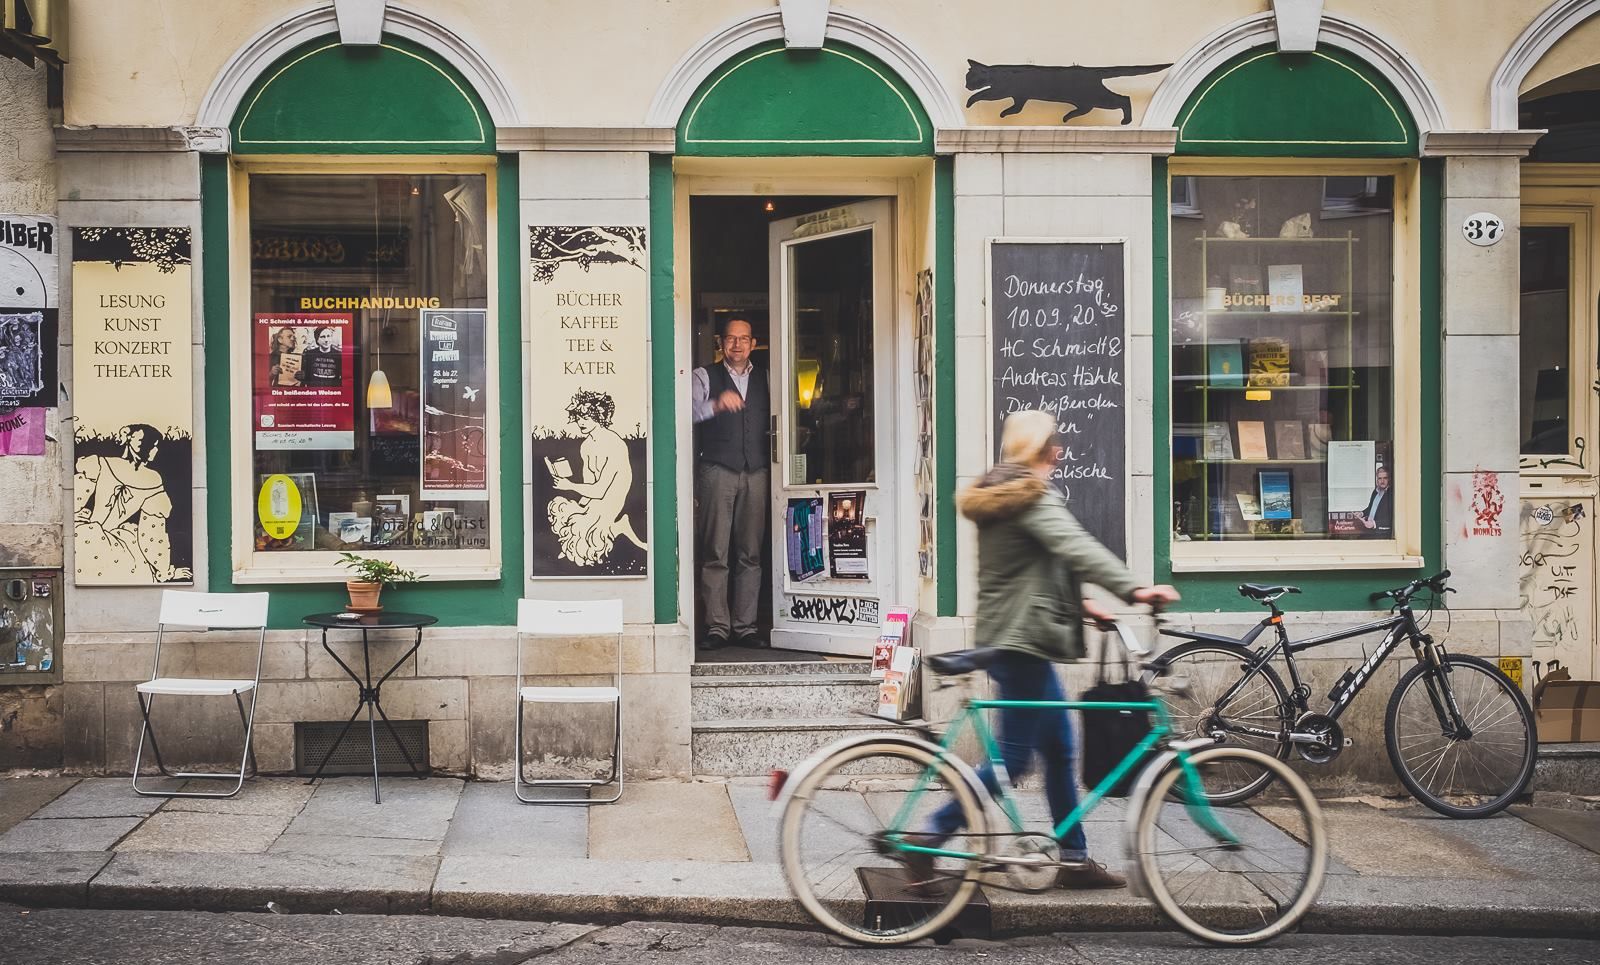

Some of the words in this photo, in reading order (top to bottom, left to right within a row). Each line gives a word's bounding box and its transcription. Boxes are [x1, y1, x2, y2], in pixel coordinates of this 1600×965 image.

[1468, 219, 1500, 239] 37
[0, 220, 53, 254] IBER
[1003, 273, 1110, 306] Donnerstag,
[99, 294, 165, 308] LESUNG
[300, 297, 441, 309] BUCHHANDLUNG
[556, 290, 623, 306] BÜCHER
[1223, 292, 1297, 306] BÜCHERS
[1302, 294, 1342, 306] BEST
[104, 318, 162, 331] KUNST
[560, 316, 619, 329] KAFFEE
[94, 341, 172, 354] KONZERT
[565, 339, 596, 352] TEE
[599, 339, 614, 352] &
[1000, 337, 1025, 357] HC
[1032, 336, 1107, 357] Schmidt
[93, 364, 173, 378] THEATER
[563, 361, 616, 375] KATER
[1001, 366, 1068, 388] Andreas
[1072, 365, 1122, 387] Hähle
[1047, 462, 1113, 480] alische
[430, 517, 439, 532] &
[443, 516, 486, 532] Quist
[1472, 527, 1502, 537] MONKEYS
[1340, 632, 1394, 705] STEVENS
